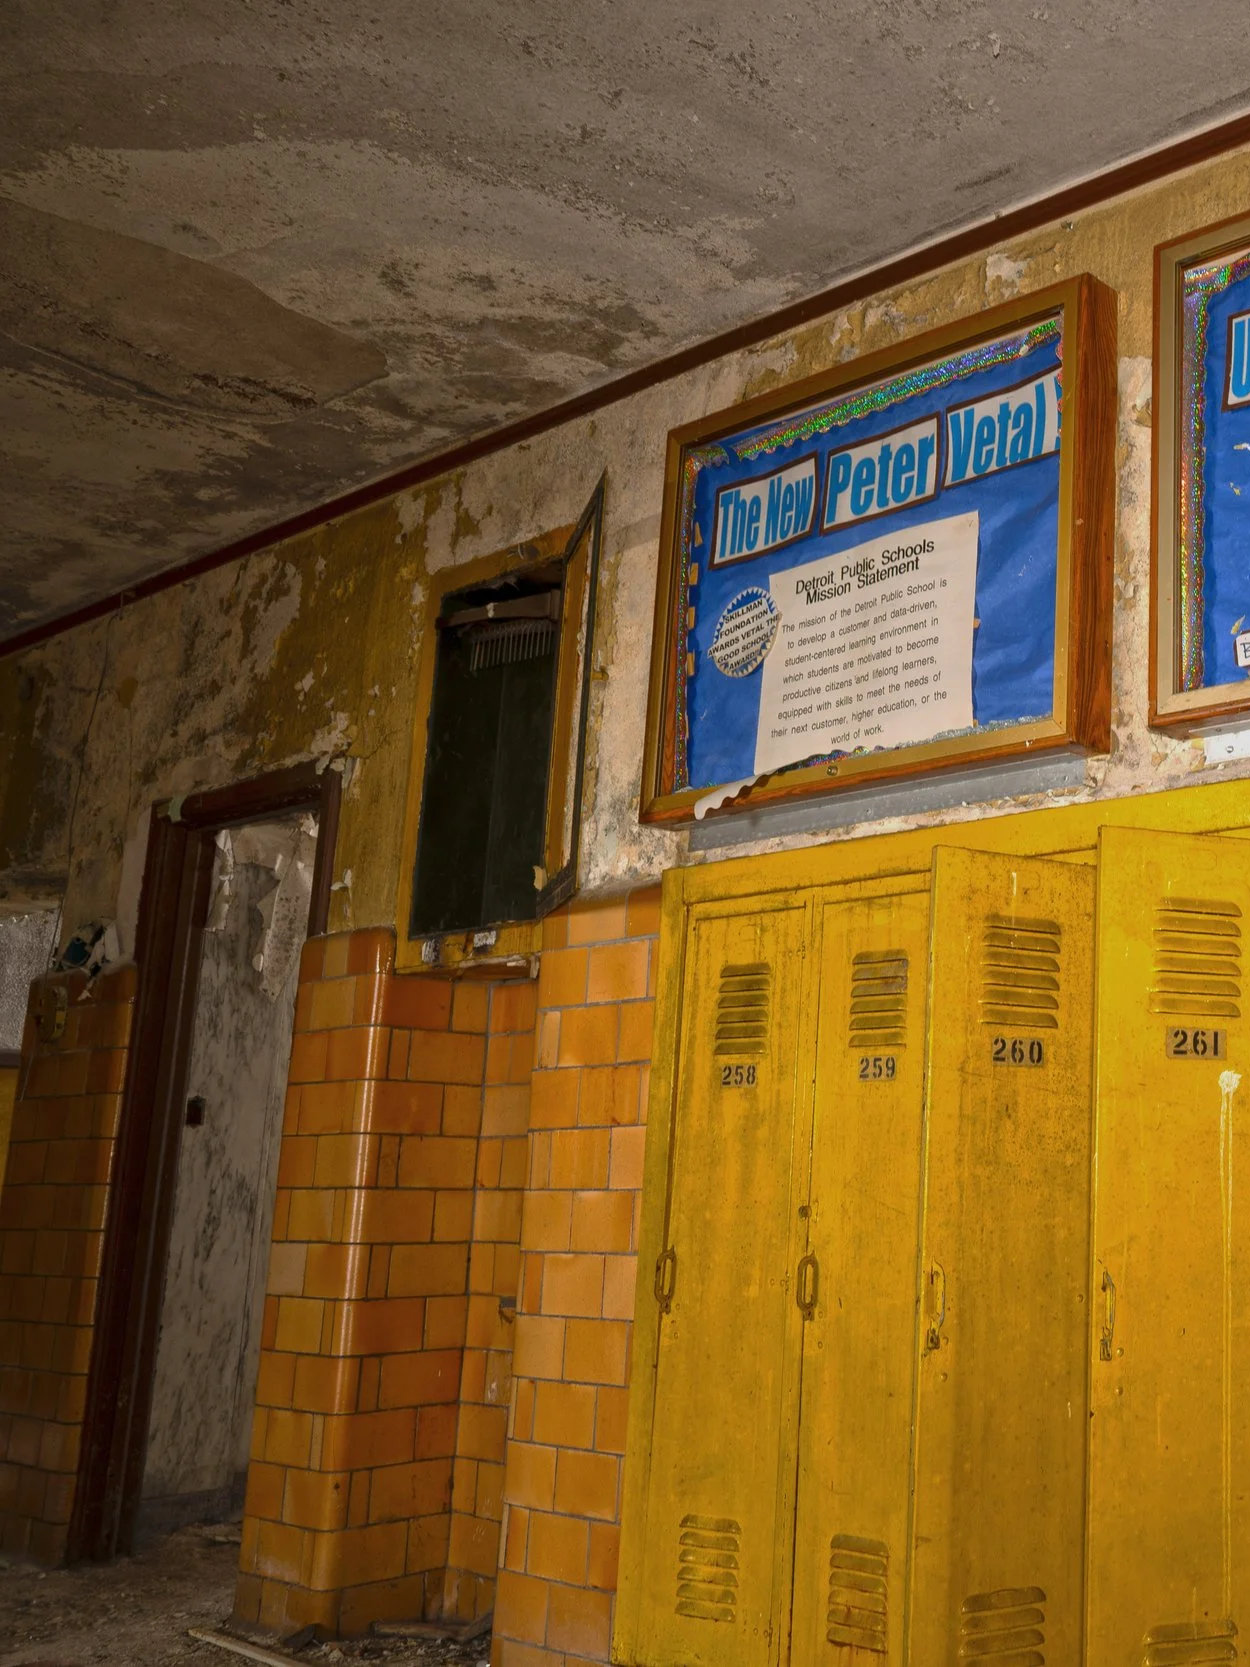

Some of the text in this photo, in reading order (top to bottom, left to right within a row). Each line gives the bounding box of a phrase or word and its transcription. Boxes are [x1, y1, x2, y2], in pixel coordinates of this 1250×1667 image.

[719, 490, 761, 559] The
[764, 473, 815, 547] New
[826, 434, 935, 525] Peter
[796, 539, 934, 595] Detroit Public Schools
[806, 556, 920, 605] Mission Statement
[720, 608, 768, 639] FOUNDATION
[725, 599, 763, 624] SKILLMAN
[782, 578, 947, 634] The mission of the Detroit Public School is
[787, 600, 938, 650] to develop a customer and data-driven,
[708, 636, 740, 656] AWARDS
[741, 624, 764, 641] VETAL
[717, 649, 740, 664] GOOD
[782, 635, 939, 684] which students are motivated to become
[785, 616, 939, 668] student-centered learning environment in
[777, 671, 942, 720] equipped with skills to meet the needs of
[782, 685, 822, 704] productive
[825, 678, 853, 693] citizens
[872, 664, 899, 680] lifelong
[902, 655, 937, 672] learners,
[771, 690, 947, 738] their next customer, higher education, or the
[830, 723, 884, 744] world of work.
[993, 1037, 1043, 1064] 260
[1173, 1029, 1220, 1058] 261
[722, 1064, 756, 1086] 258
[859, 1056, 896, 1080] 259
